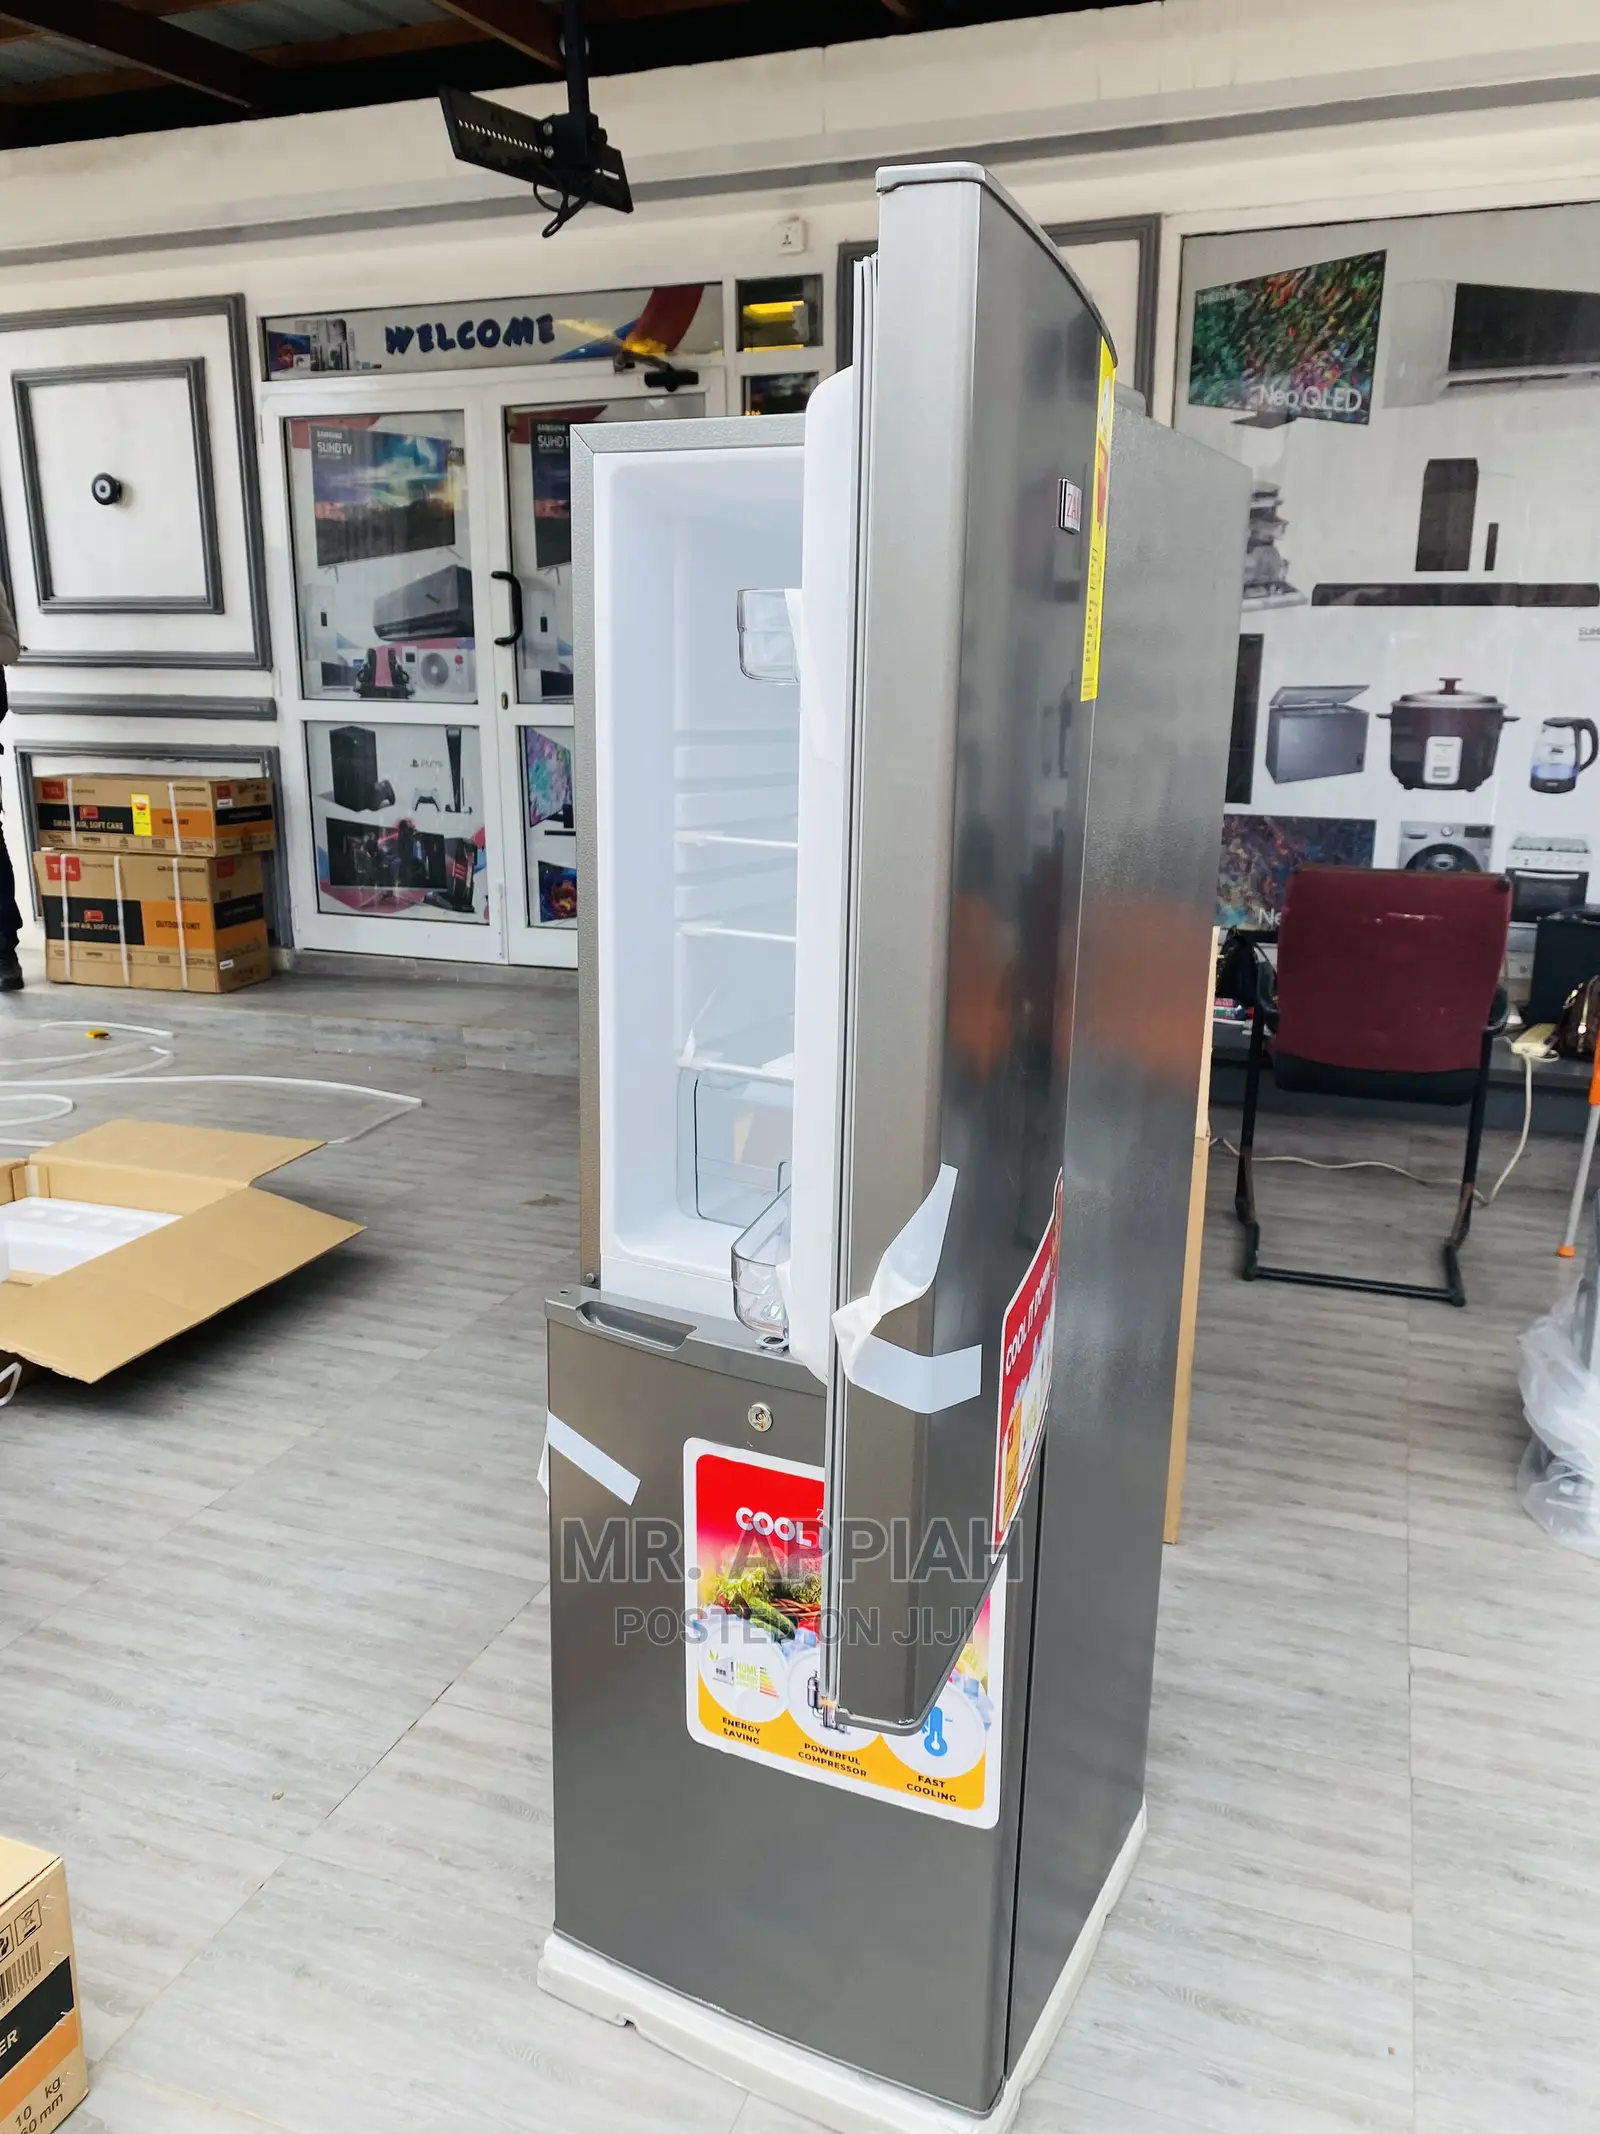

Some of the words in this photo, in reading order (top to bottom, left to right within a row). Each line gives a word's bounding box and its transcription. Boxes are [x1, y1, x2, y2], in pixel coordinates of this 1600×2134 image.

[384, 313, 556, 355] WELCOME
[1258, 384, 1299, 406] Neo
[1303, 387, 1362, 412] QLED
[51, 864, 77, 874] TL
[1005, 1315, 1027, 1376] COOL
[736, 1507, 812, 1548] COOL
[722, 1716, 761, 1735] ENERGY
[723, 1727, 760, 1745] SAVING
[798, 1751, 867, 1777] COMPRESSOR
[804, 1743, 861, 1766] POWERFUL
[906, 1783, 957, 1803] COOLING
[918, 1775, 946, 1788] FAST
[15, 2106, 32, 2128] 10
[44, 2076, 62, 2100] kg
[40, 2093, 64, 2124] mm
